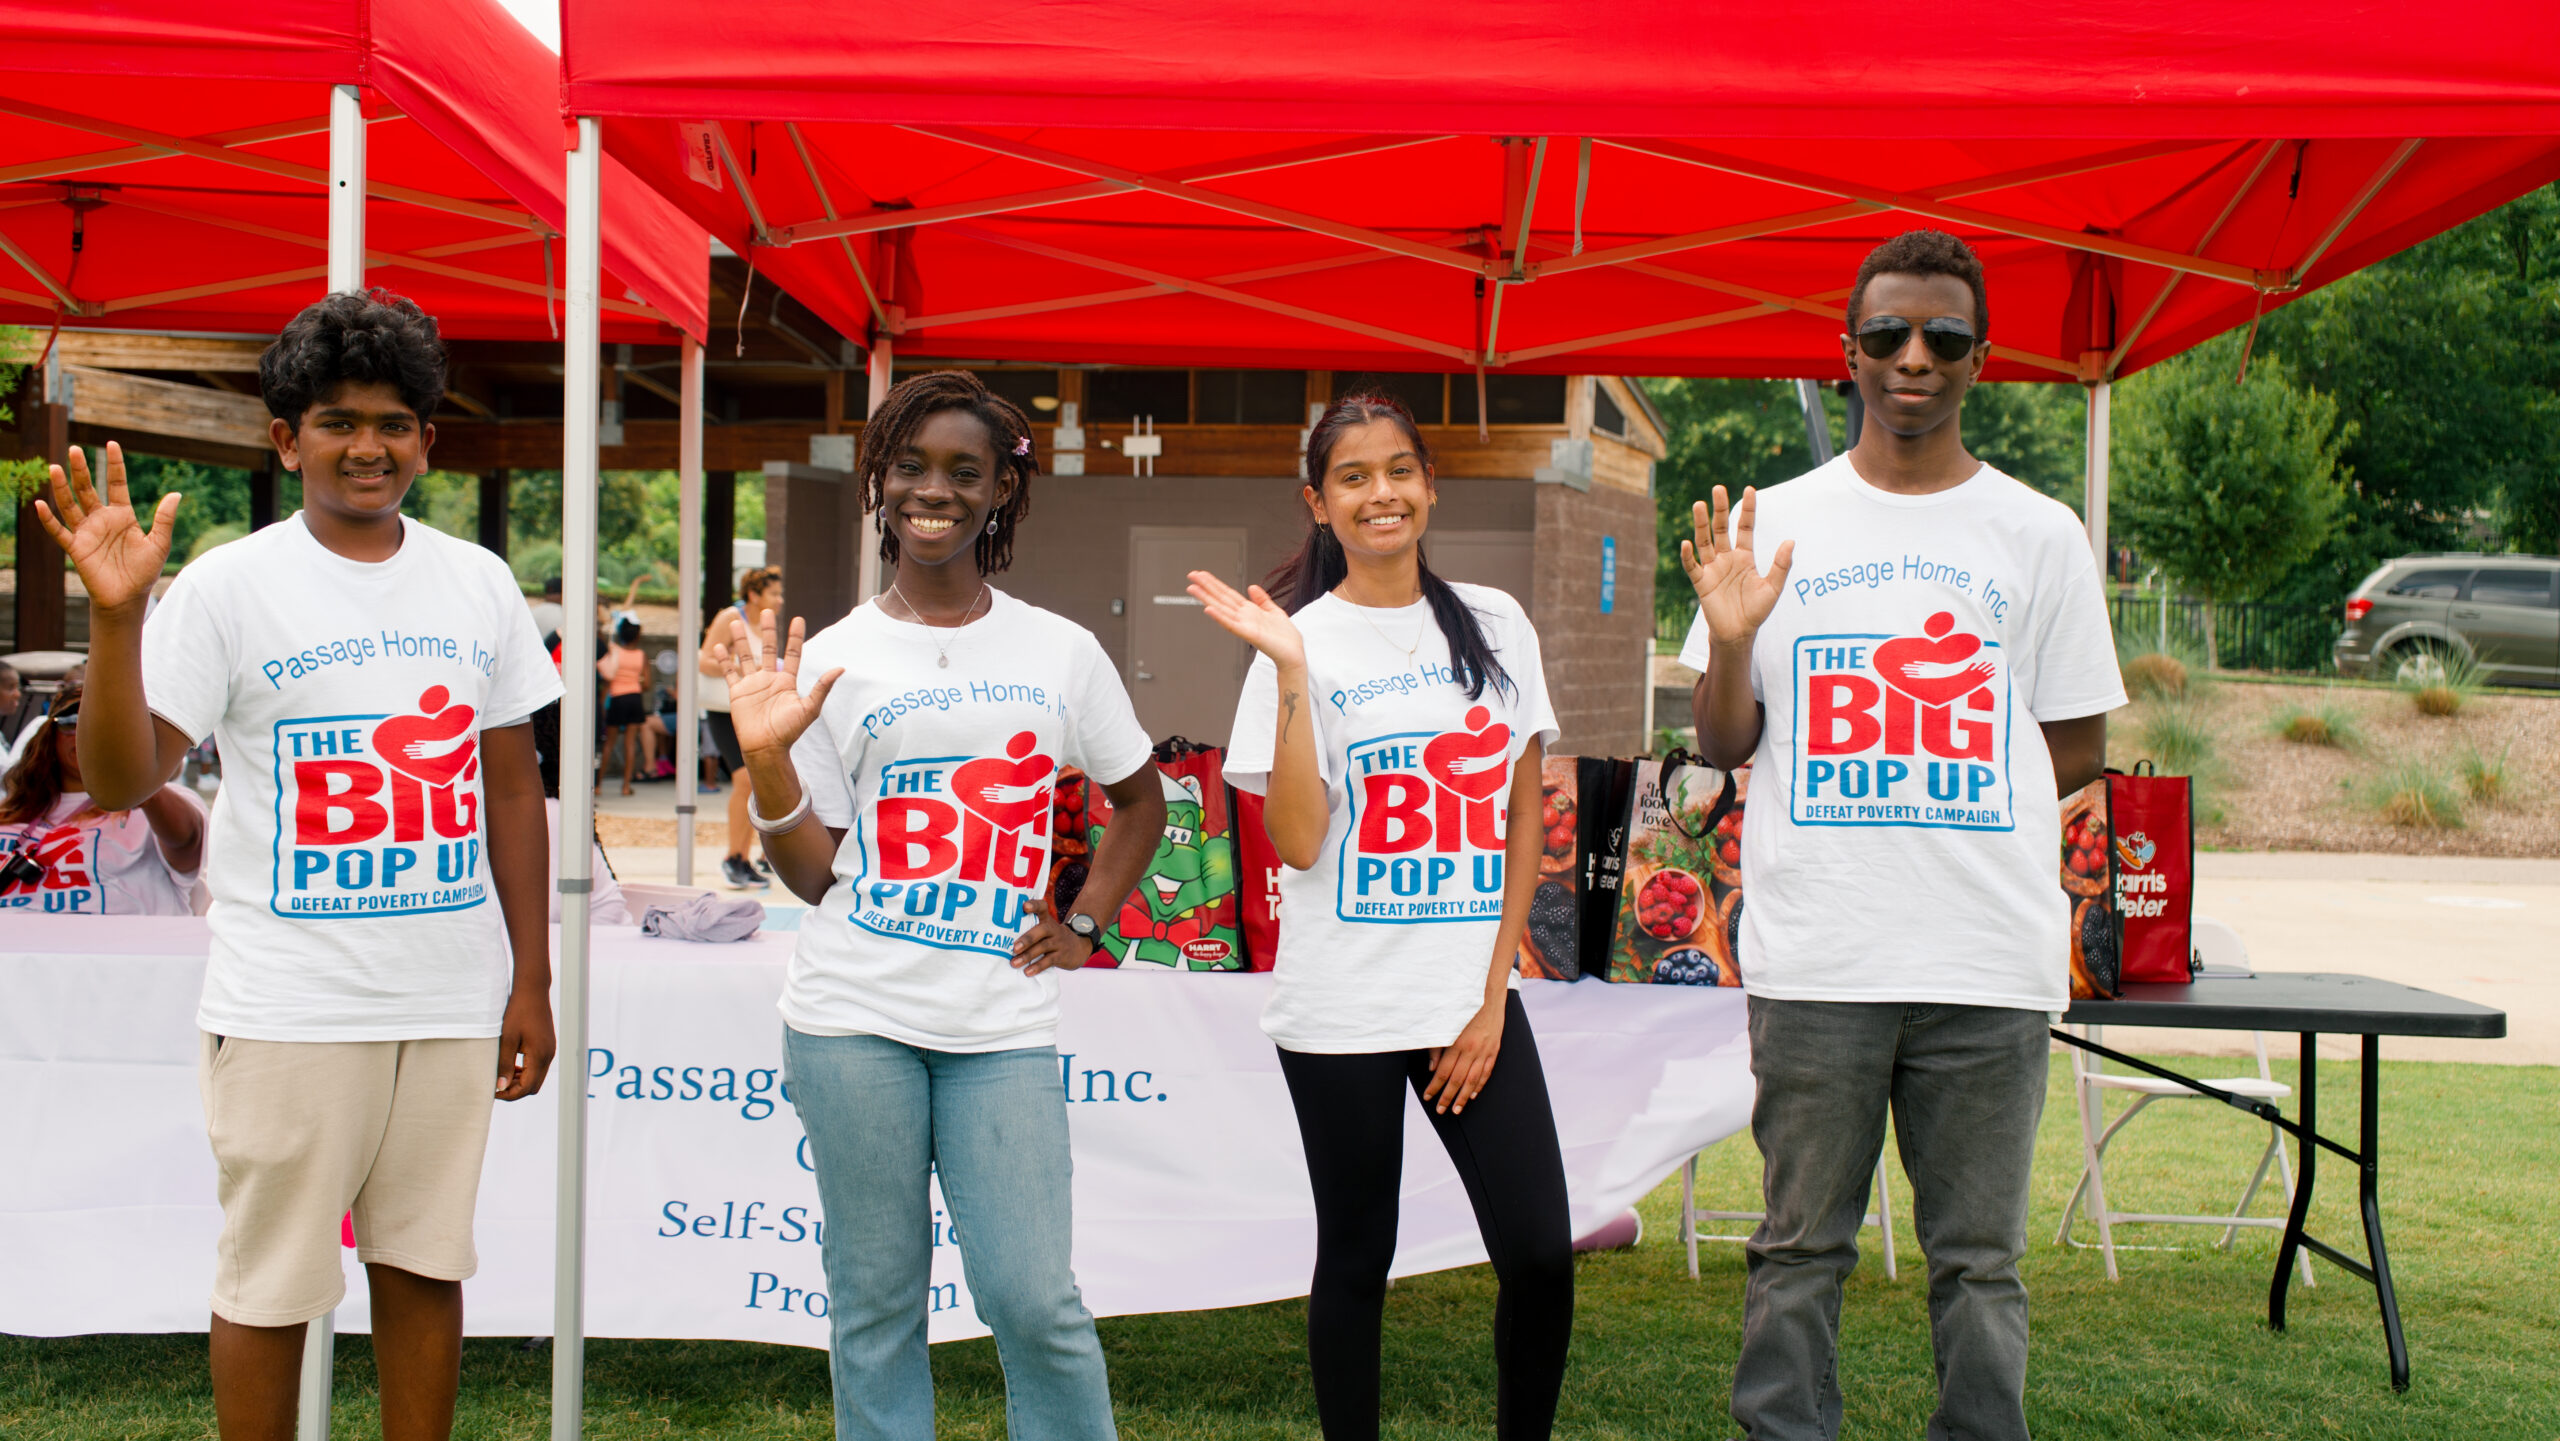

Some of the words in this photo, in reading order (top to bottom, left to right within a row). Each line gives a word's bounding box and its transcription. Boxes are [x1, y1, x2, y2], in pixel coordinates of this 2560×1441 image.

[1794, 561, 1894, 606] Passage
[1903, 554, 1973, 596] Home,
[1982, 578, 2008, 624] Inc.
[262, 634, 376, 691] Passage
[381, 630, 463, 666] Home,
[472, 639, 495, 677] Inc
[1804, 646, 1867, 671] THE
[862, 685, 963, 739] Passage
[969, 680, 1051, 713] Home,
[1330, 671, 1418, 717] Passage
[1807, 673, 1995, 763] BIG
[288, 728, 364, 757] THE
[1355, 745, 1418, 774] THE
[294, 755, 478, 845] BIG
[879, 770, 943, 797] THE
[1806, 759, 1909, 799] POP
[1927, 762, 1996, 802] UP
[1641, 811, 1671, 827] love
[1805, 804, 1853, 819] DEFEAT
[1858, 805, 1920, 821] POVERTY
[1926, 807, 2000, 824] CAMPAIGN
[877, 797, 1048, 889] BIG
[294, 847, 417, 890] POP
[437, 838, 479, 884] UP
[1357, 857, 1456, 897] POP
[1473, 854, 1502, 893] U
[43, 889, 92, 914] UP
[291, 896, 351, 911] DEFEAT
[358, 891, 429, 910] POVERTY
[433, 883, 484, 905] CAMPAIGN
[870, 881, 978, 922] POP
[992, 887, 1030, 933] UP
[1355, 901, 1405, 916] DEFEAT
[1408, 899, 1465, 916] POVERTY
[2114, 892, 2168, 918] Teeter
[863, 909, 914, 933] DEFEAT
[917, 920, 979, 944] POVERTY
[1189, 944, 1222, 952] HARRY
[1058, 1054, 1168, 1103] Inc.
